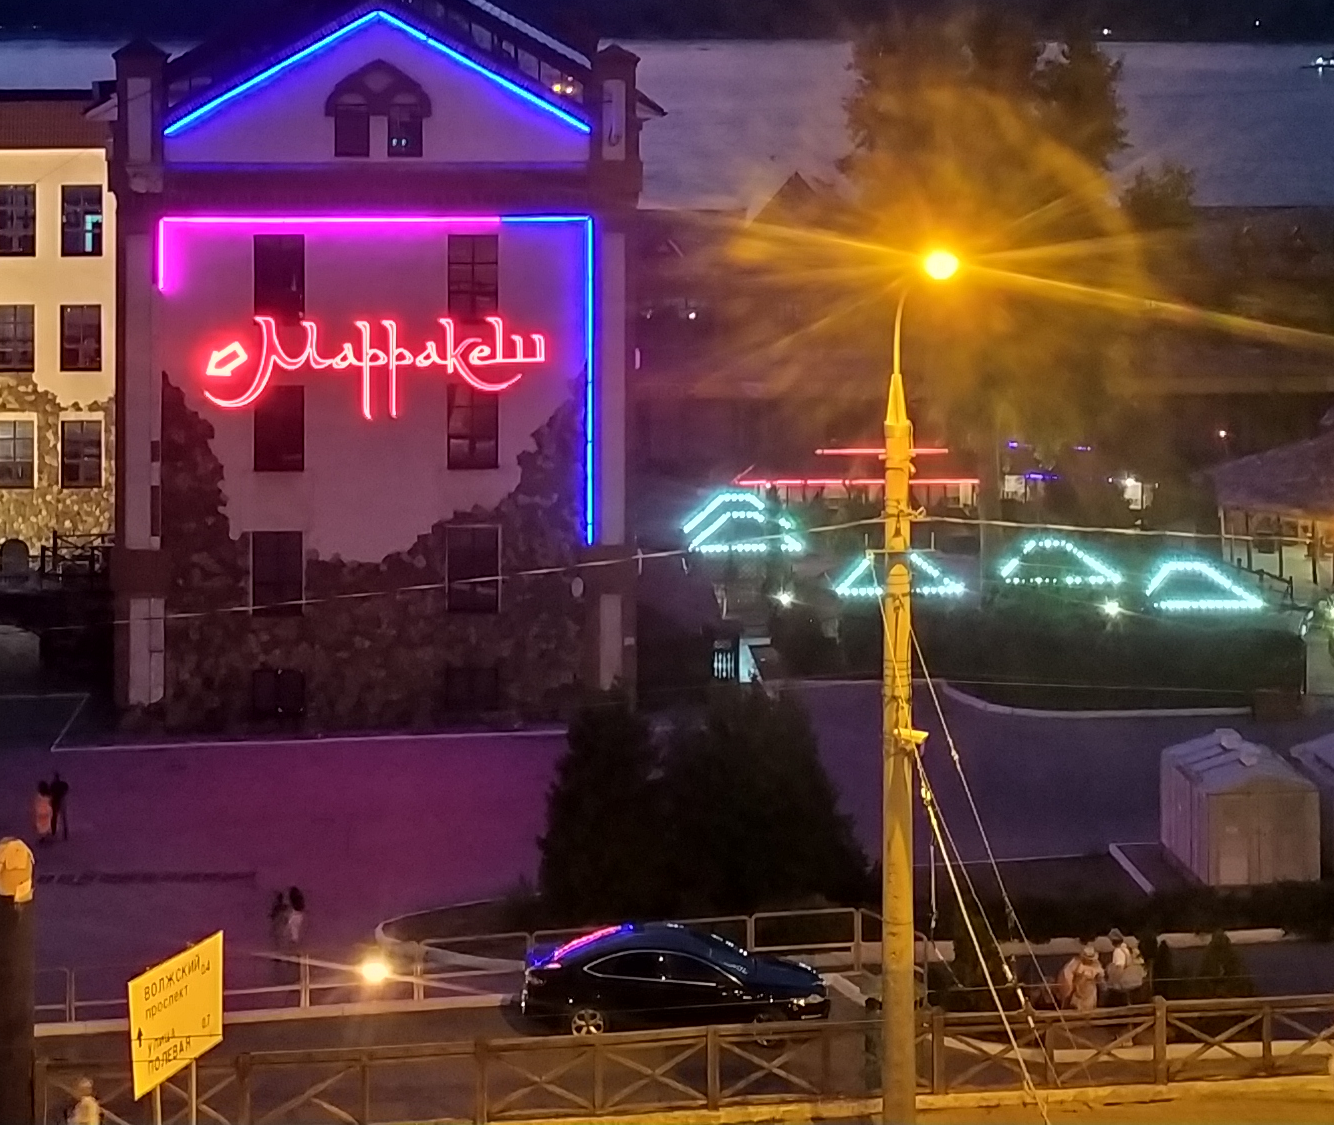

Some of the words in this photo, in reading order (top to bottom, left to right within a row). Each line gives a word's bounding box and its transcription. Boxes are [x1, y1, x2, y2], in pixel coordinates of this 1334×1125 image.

[204, 315, 547, 421] Марракеш
[144, 954, 200, 1002] ВОЛЖСКИЙ
[145, 984, 188, 1021] проспект
[147, 1035, 191, 1076] ПОЛЕВАЯ
[148, 1027, 176, 1059] улица
